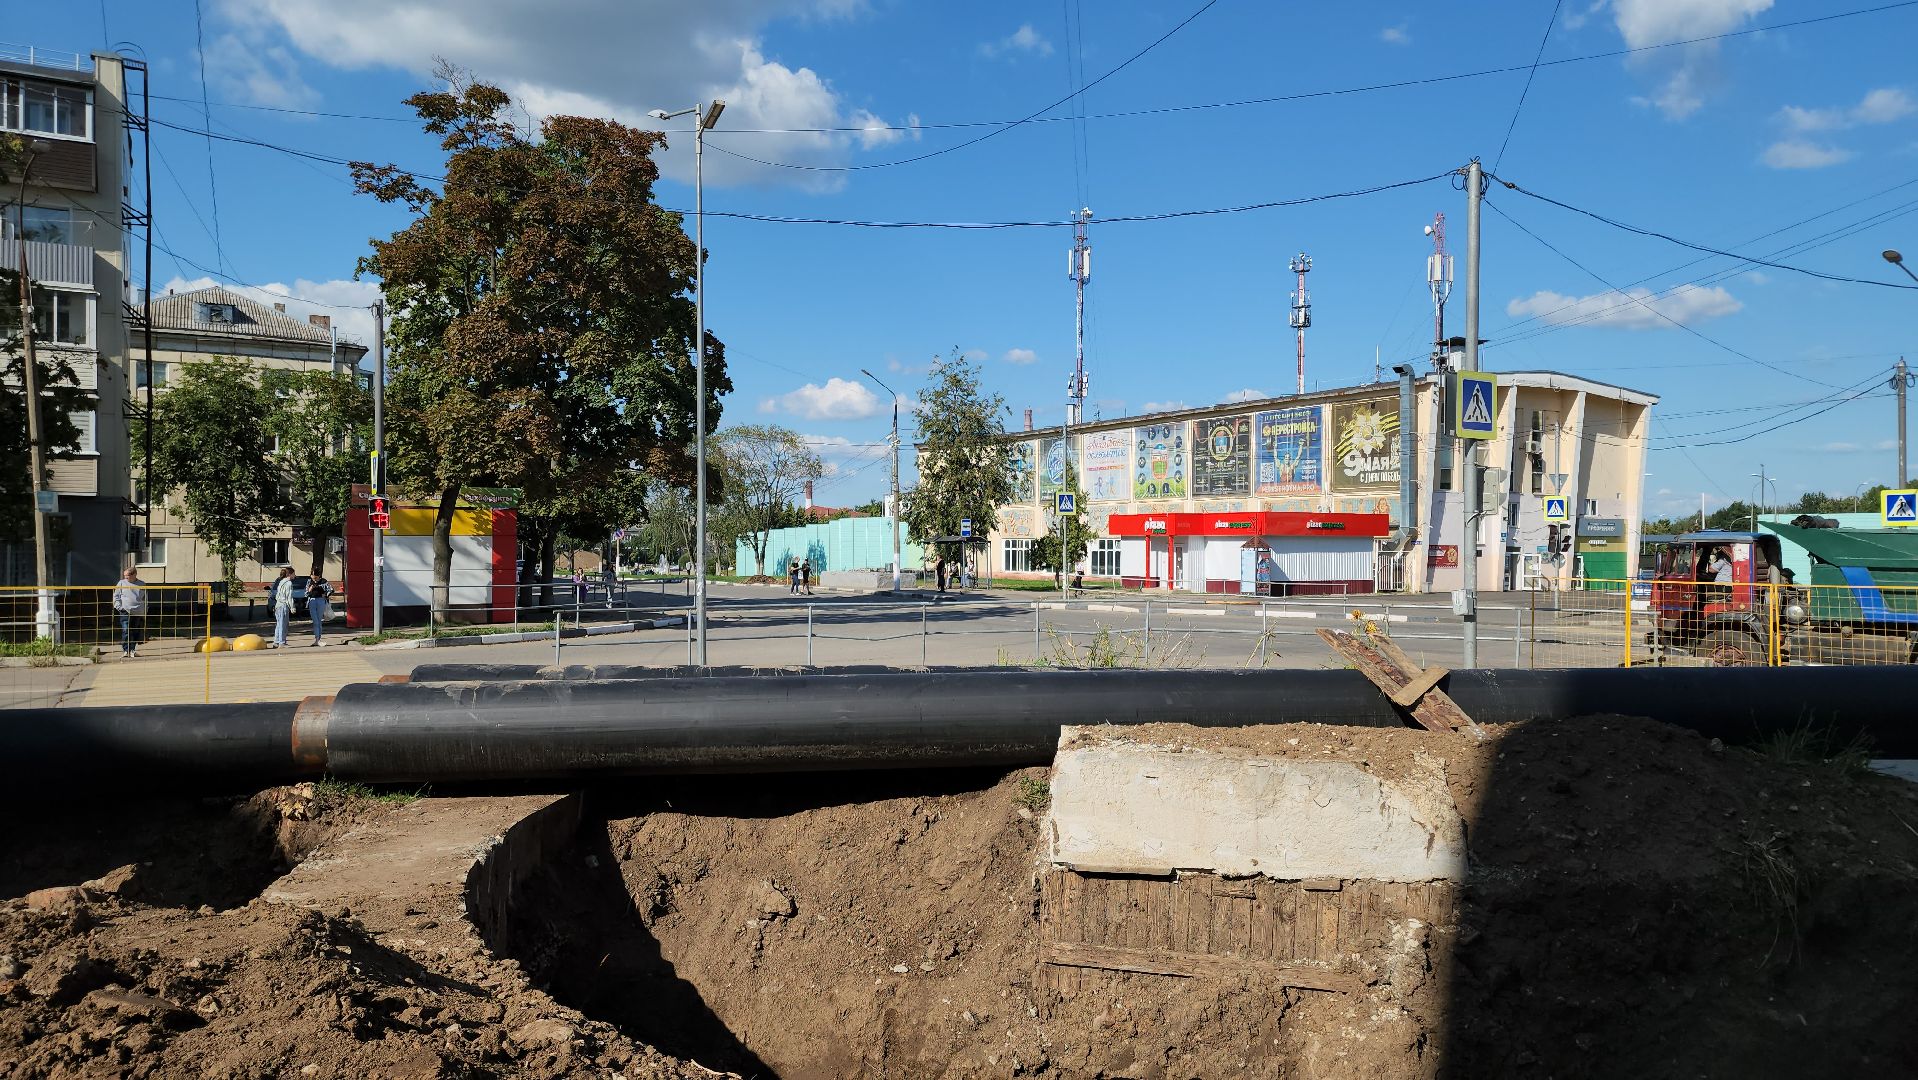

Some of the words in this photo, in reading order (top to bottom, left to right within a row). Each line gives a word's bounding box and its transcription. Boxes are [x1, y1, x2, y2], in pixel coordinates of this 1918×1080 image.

[1271, 420, 1316, 436] ПЕРЕСТРОЙКА
[1343, 449, 1361, 477] 9
[1360, 455, 1390, 472] МАЯ
